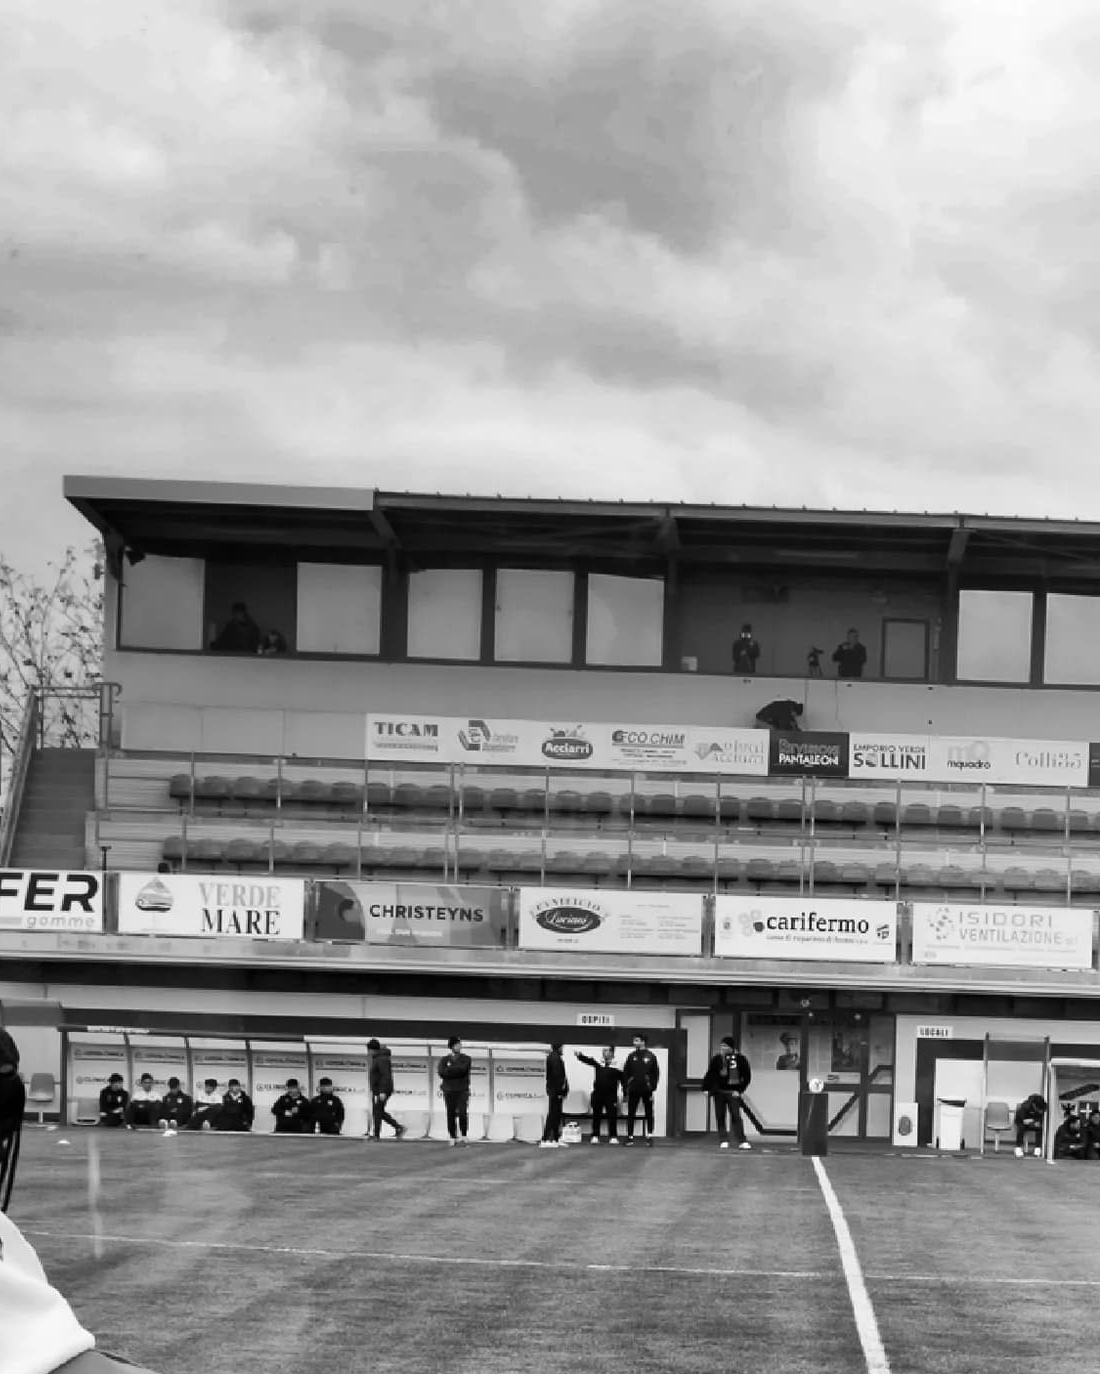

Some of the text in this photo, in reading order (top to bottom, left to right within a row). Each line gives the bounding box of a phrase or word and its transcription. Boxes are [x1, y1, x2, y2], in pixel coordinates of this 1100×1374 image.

[374, 721, 439, 737] TICAM
[199, 882, 280, 908] VERDE
[202, 908, 281, 935] MARE
[370, 904, 484, 922] CHRISTEYNS
[959, 912, 1052, 927] ISIDORI
[26, 915, 95, 929] gomme
[767, 912, 869, 934] carifermo
[960, 929, 1062, 945] VENTILAZIONE
